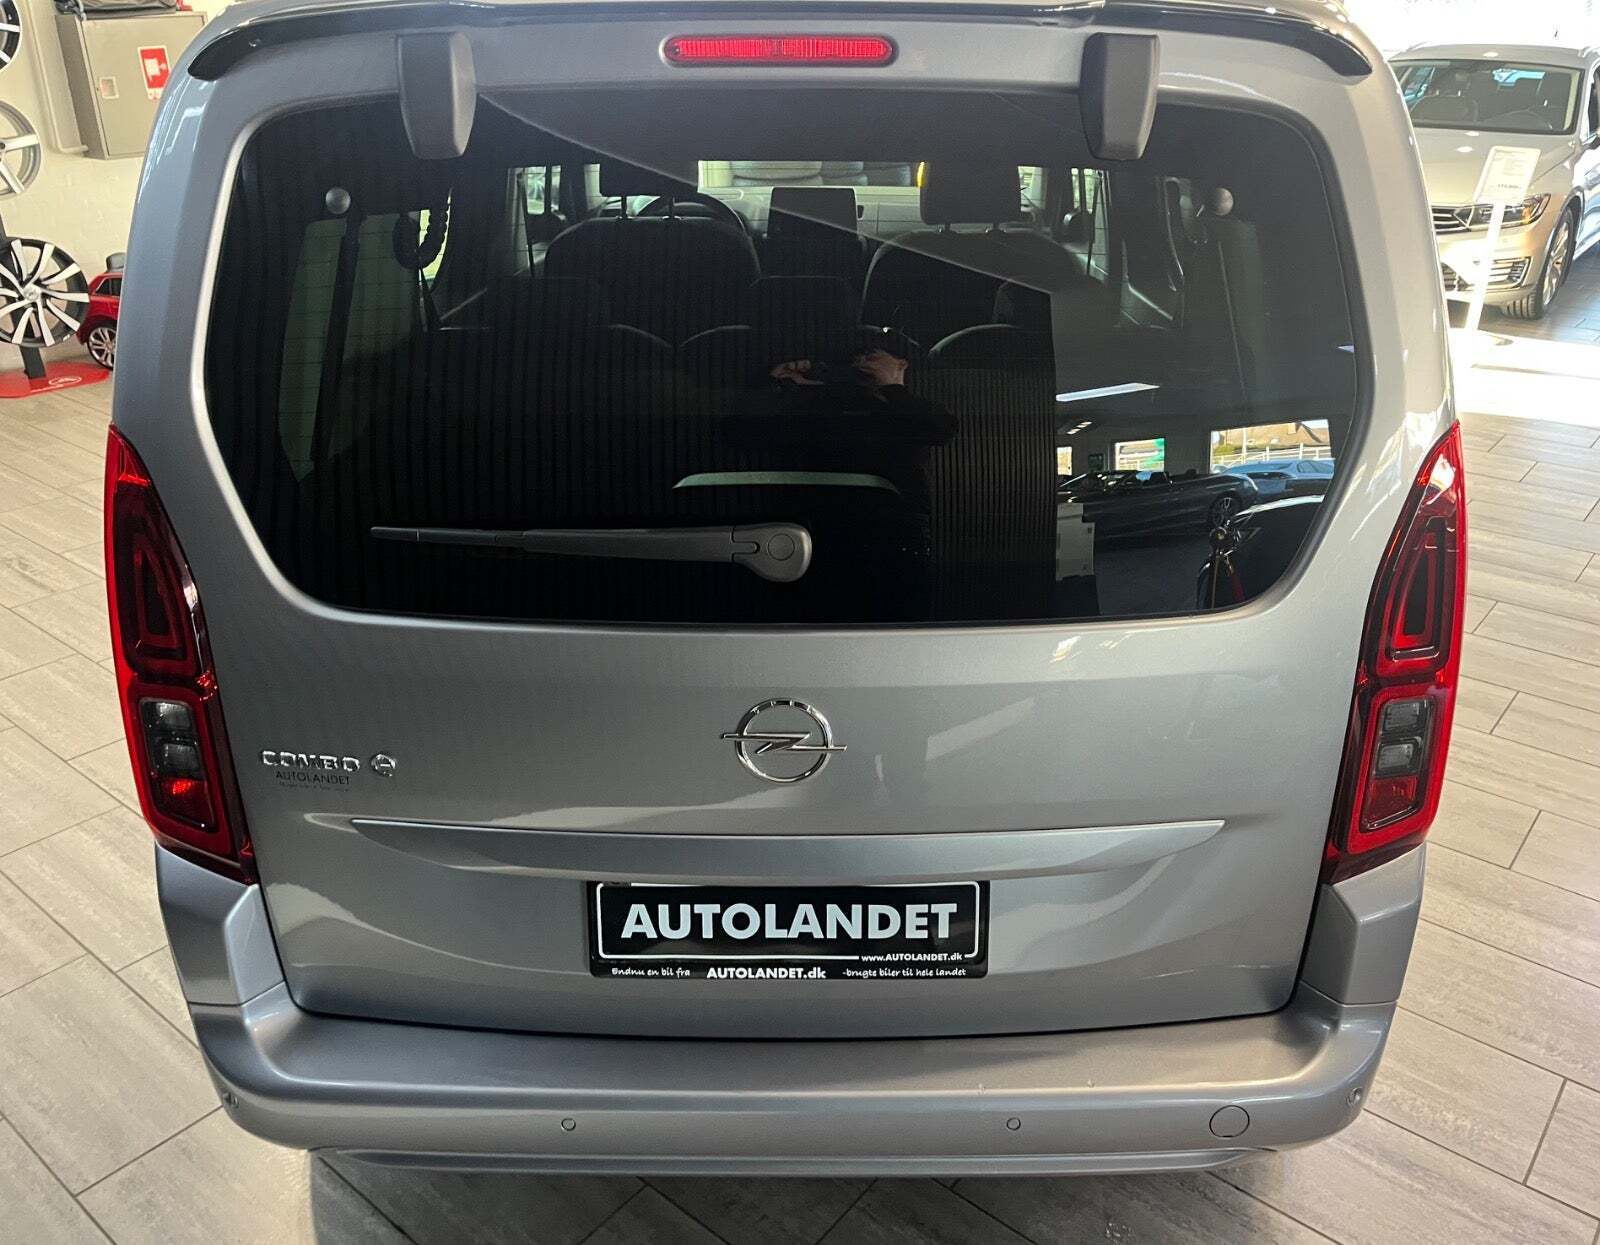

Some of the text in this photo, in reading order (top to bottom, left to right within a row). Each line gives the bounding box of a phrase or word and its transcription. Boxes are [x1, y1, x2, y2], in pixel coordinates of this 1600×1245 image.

[262, 750, 361, 772] COMBO
[275, 770, 350, 785] AUTOLANDET
[620, 903, 958, 940] AUTOLANDET
[861, 952, 963, 961] www.AUTOLANDET.dk
[647, 968, 660, 976] en
[661, 967, 674, 976] bil
[675, 967, 691, 979] fra
[706, 967, 826, 979] AUTOLANDET.dk
[879, 967, 900, 977] biler
[902, 967, 914, 976] til
[916, 968, 934, 977] hele
[935, 967, 966, 976] landet
